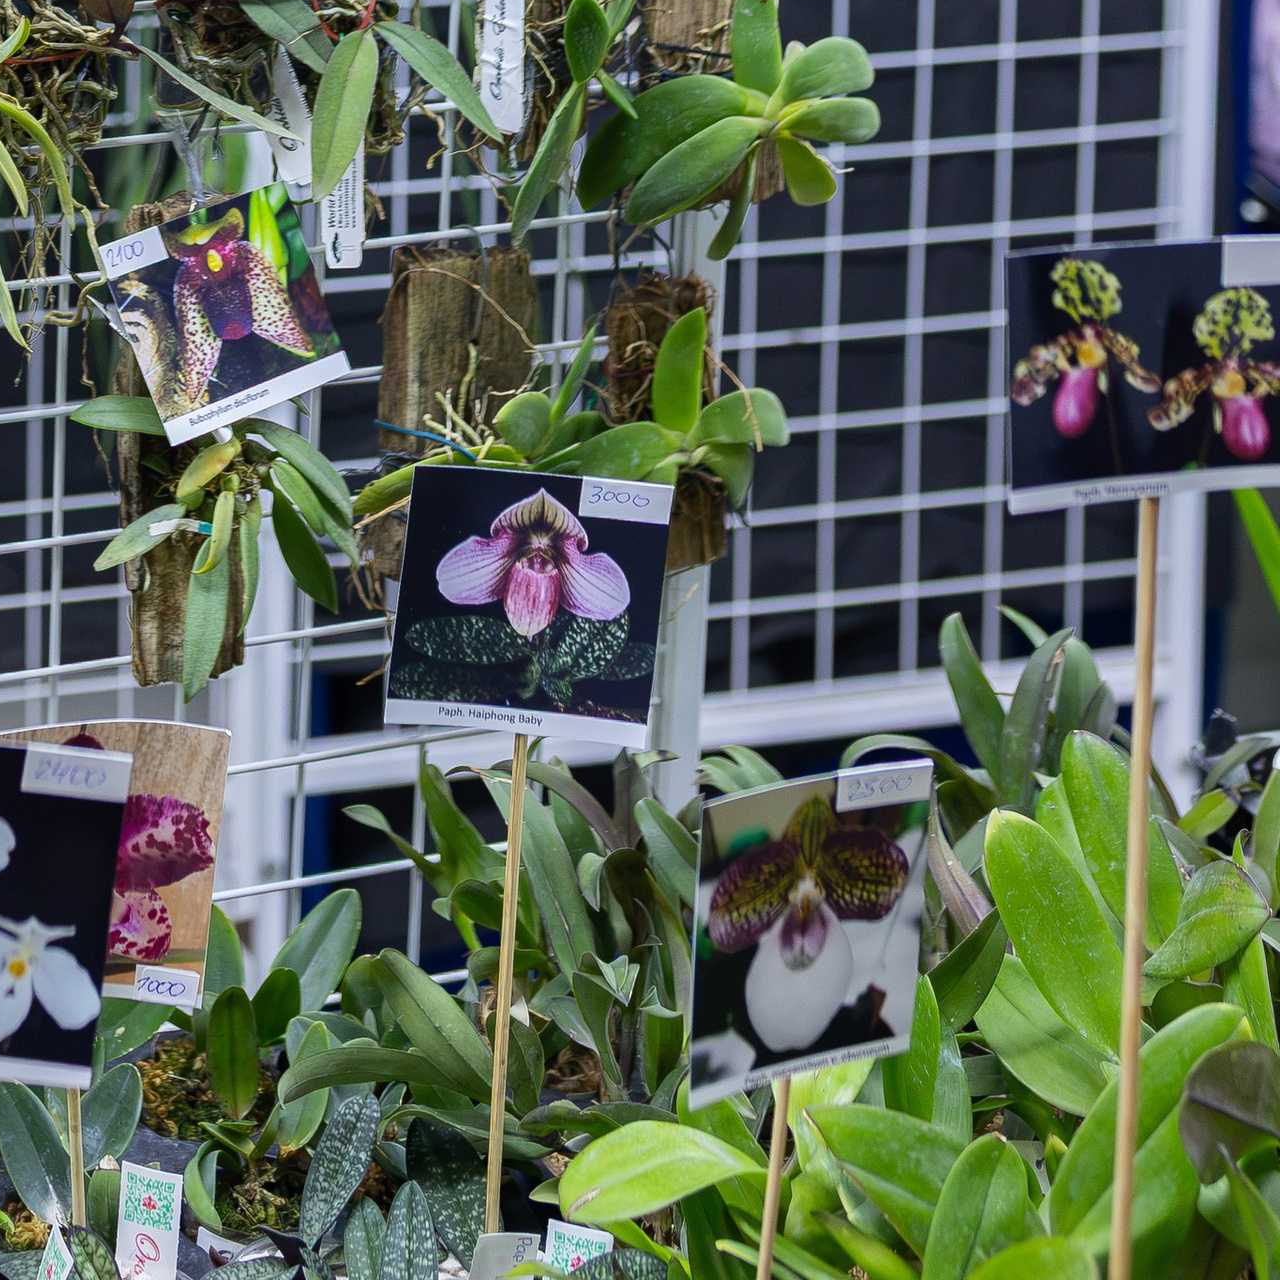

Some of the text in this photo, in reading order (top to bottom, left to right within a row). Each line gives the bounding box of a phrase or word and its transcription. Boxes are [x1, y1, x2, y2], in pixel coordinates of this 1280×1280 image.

[327, 199, 335, 227] World
[106, 241, 144, 267] 2100
[588, 485, 650, 508] 3000
[438, 706, 542, 727] Paph. Haiphong Baby
[848, 775, 912, 802] 2500
[137, 976, 186, 997] 1000
